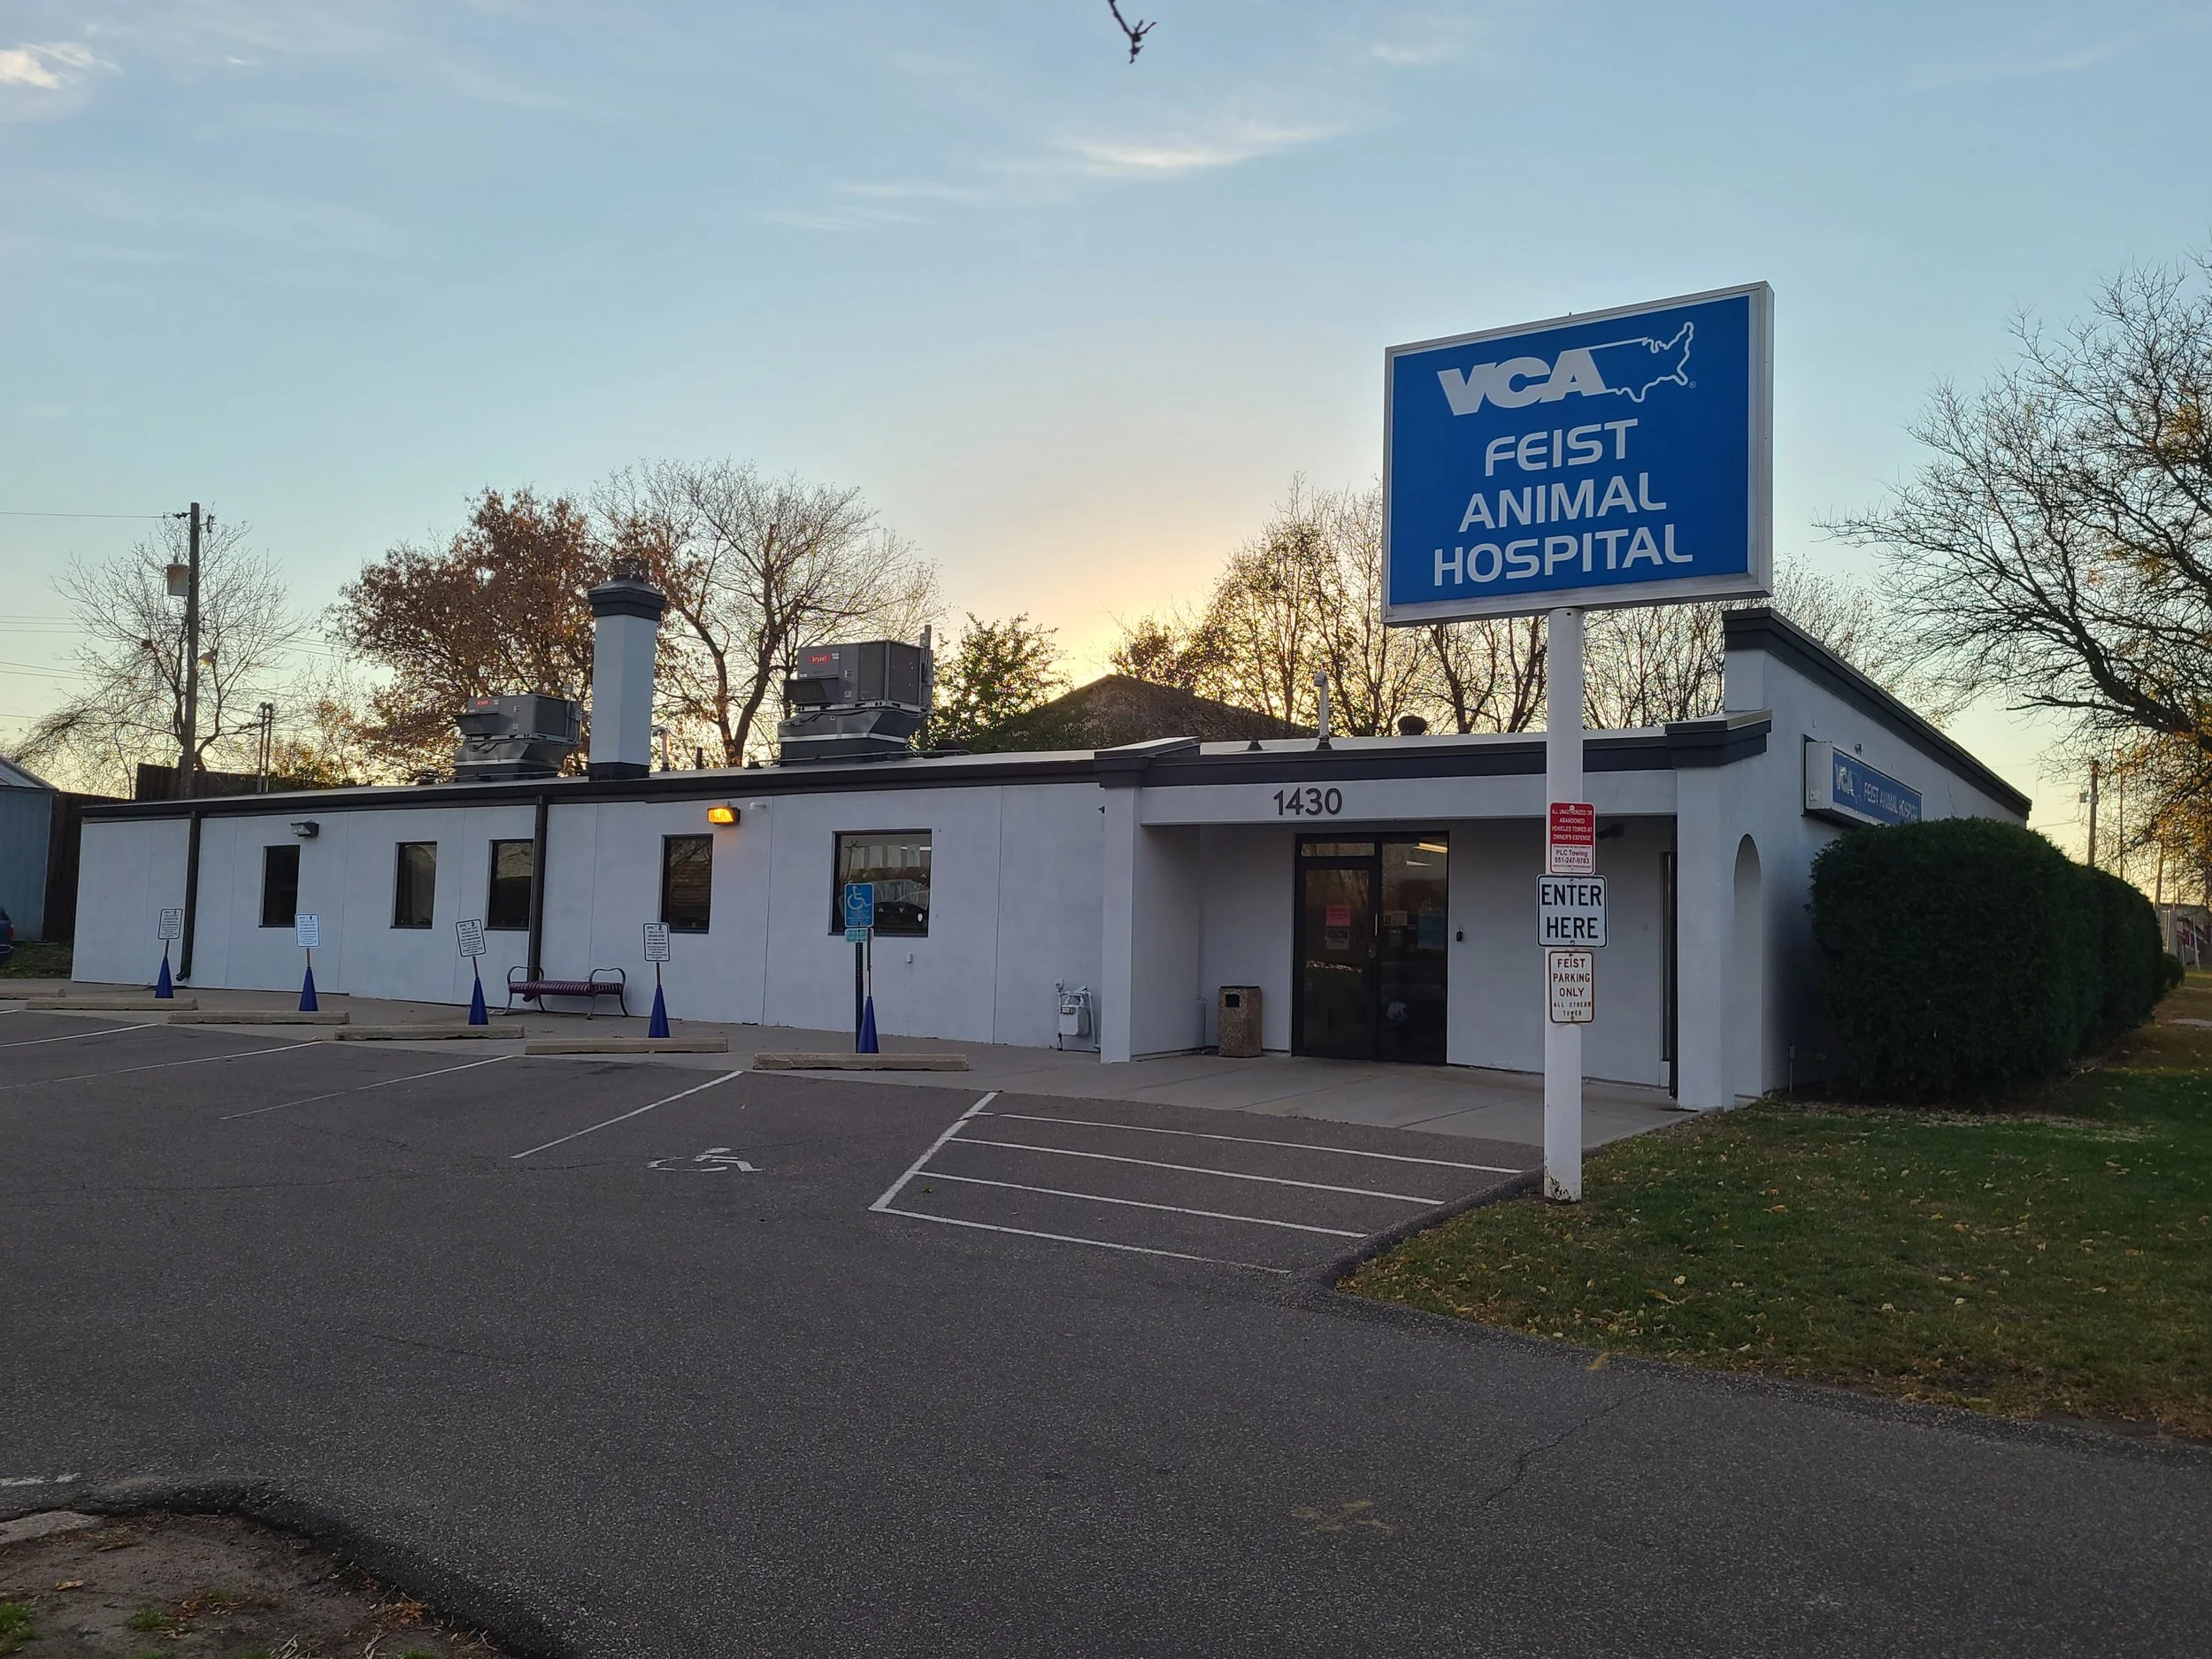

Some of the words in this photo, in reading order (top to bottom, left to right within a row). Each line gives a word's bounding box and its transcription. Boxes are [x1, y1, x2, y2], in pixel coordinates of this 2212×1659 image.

[1437, 350, 1607, 416] VCA
[1485, 419, 1639, 476] FEIST
[1458, 472, 1667, 532] ANIMAL
[1433, 524, 1694, 587] HOSPITAL
[1273, 787, 1342, 816] 1430
[1541, 884, 1601, 906] ENTER
[1547, 916, 1599, 939] HERE
[1557, 958, 1586, 968] FEIST
[1553, 973, 1590, 983] PARKING
[1559, 987, 1585, 997] ONLY
